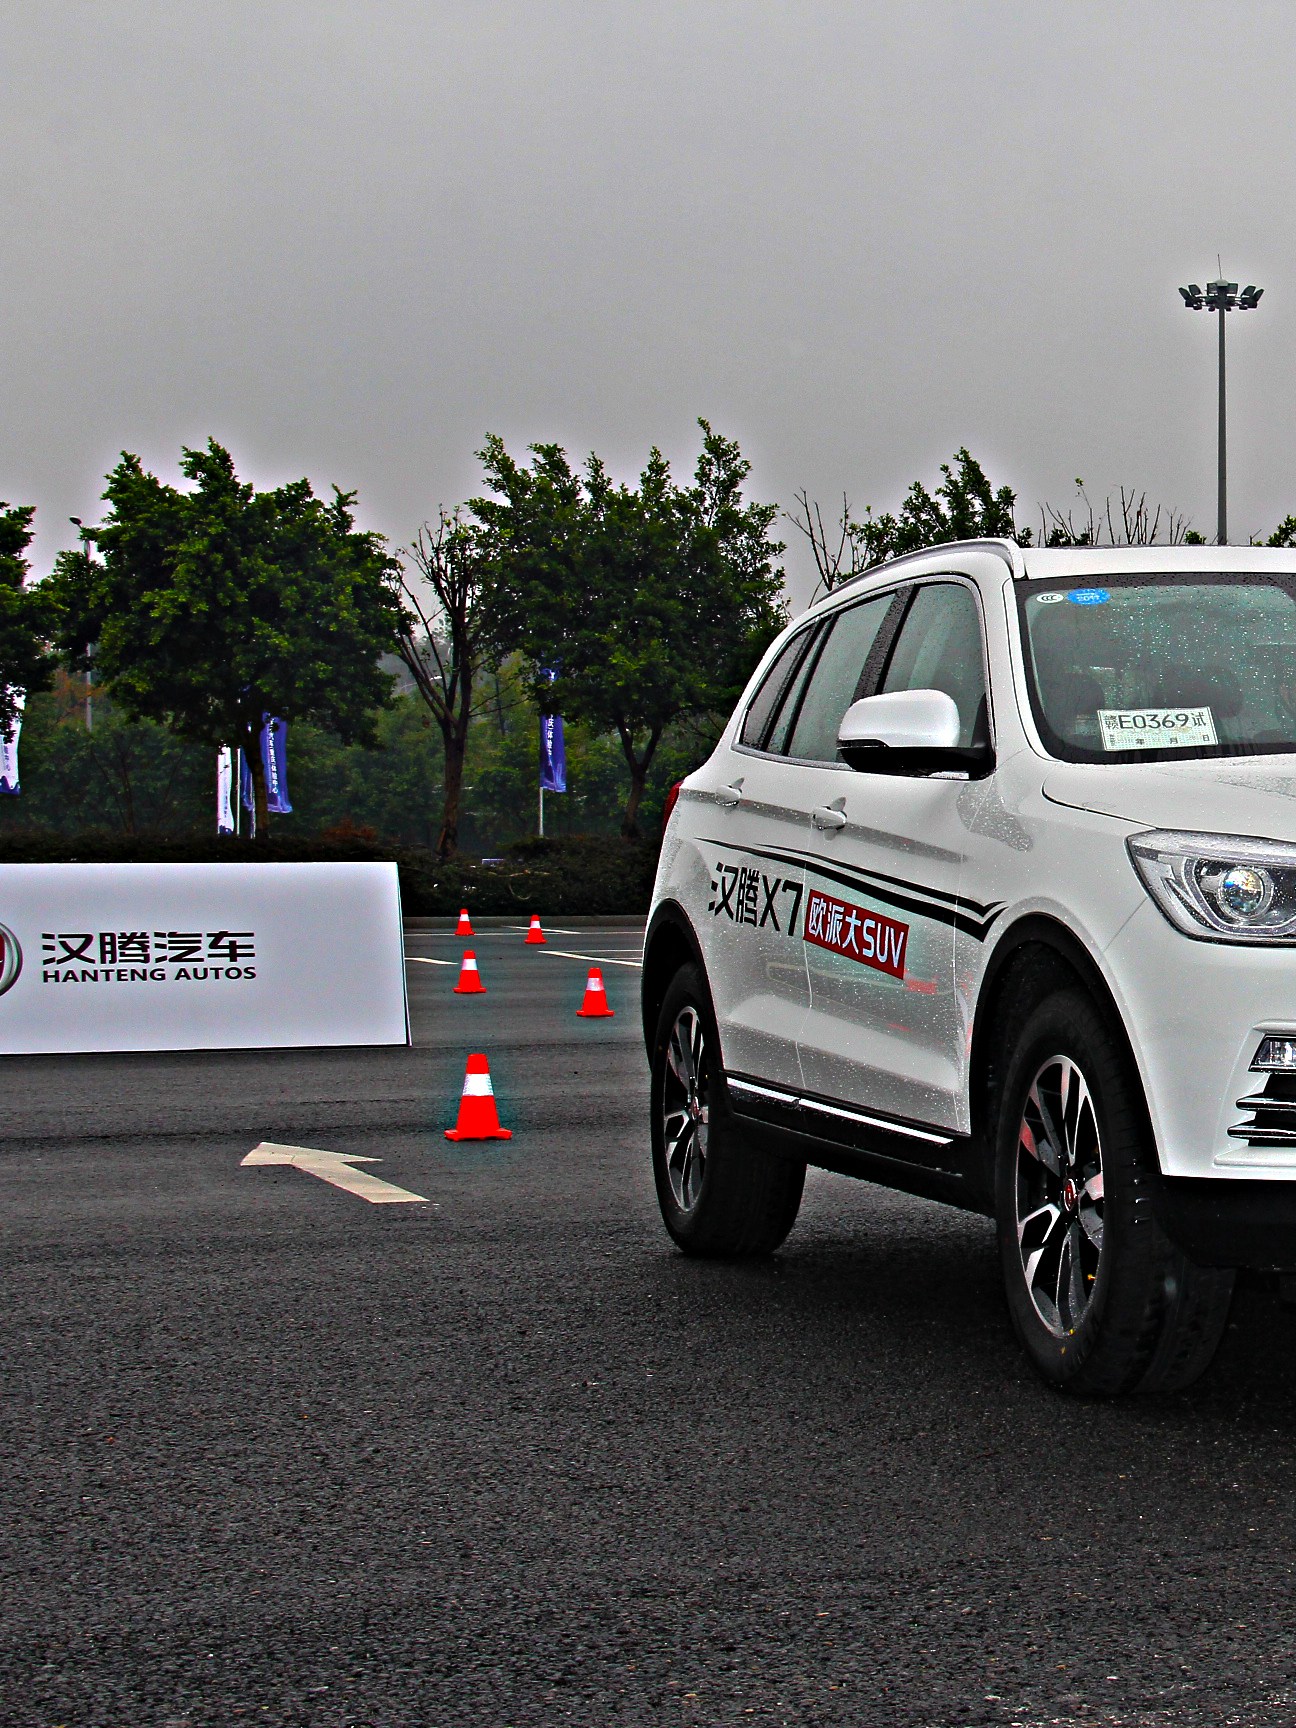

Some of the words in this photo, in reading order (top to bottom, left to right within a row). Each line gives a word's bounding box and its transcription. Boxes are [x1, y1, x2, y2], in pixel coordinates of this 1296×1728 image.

[708, 862, 803, 936] 汉腾X7
[808, 896, 904, 969] 欧派大SUV
[41, 931, 256, 966] 汉腾汽车
[43, 968, 166, 983] HANTENG
[174, 966, 257, 981] AUTOS
